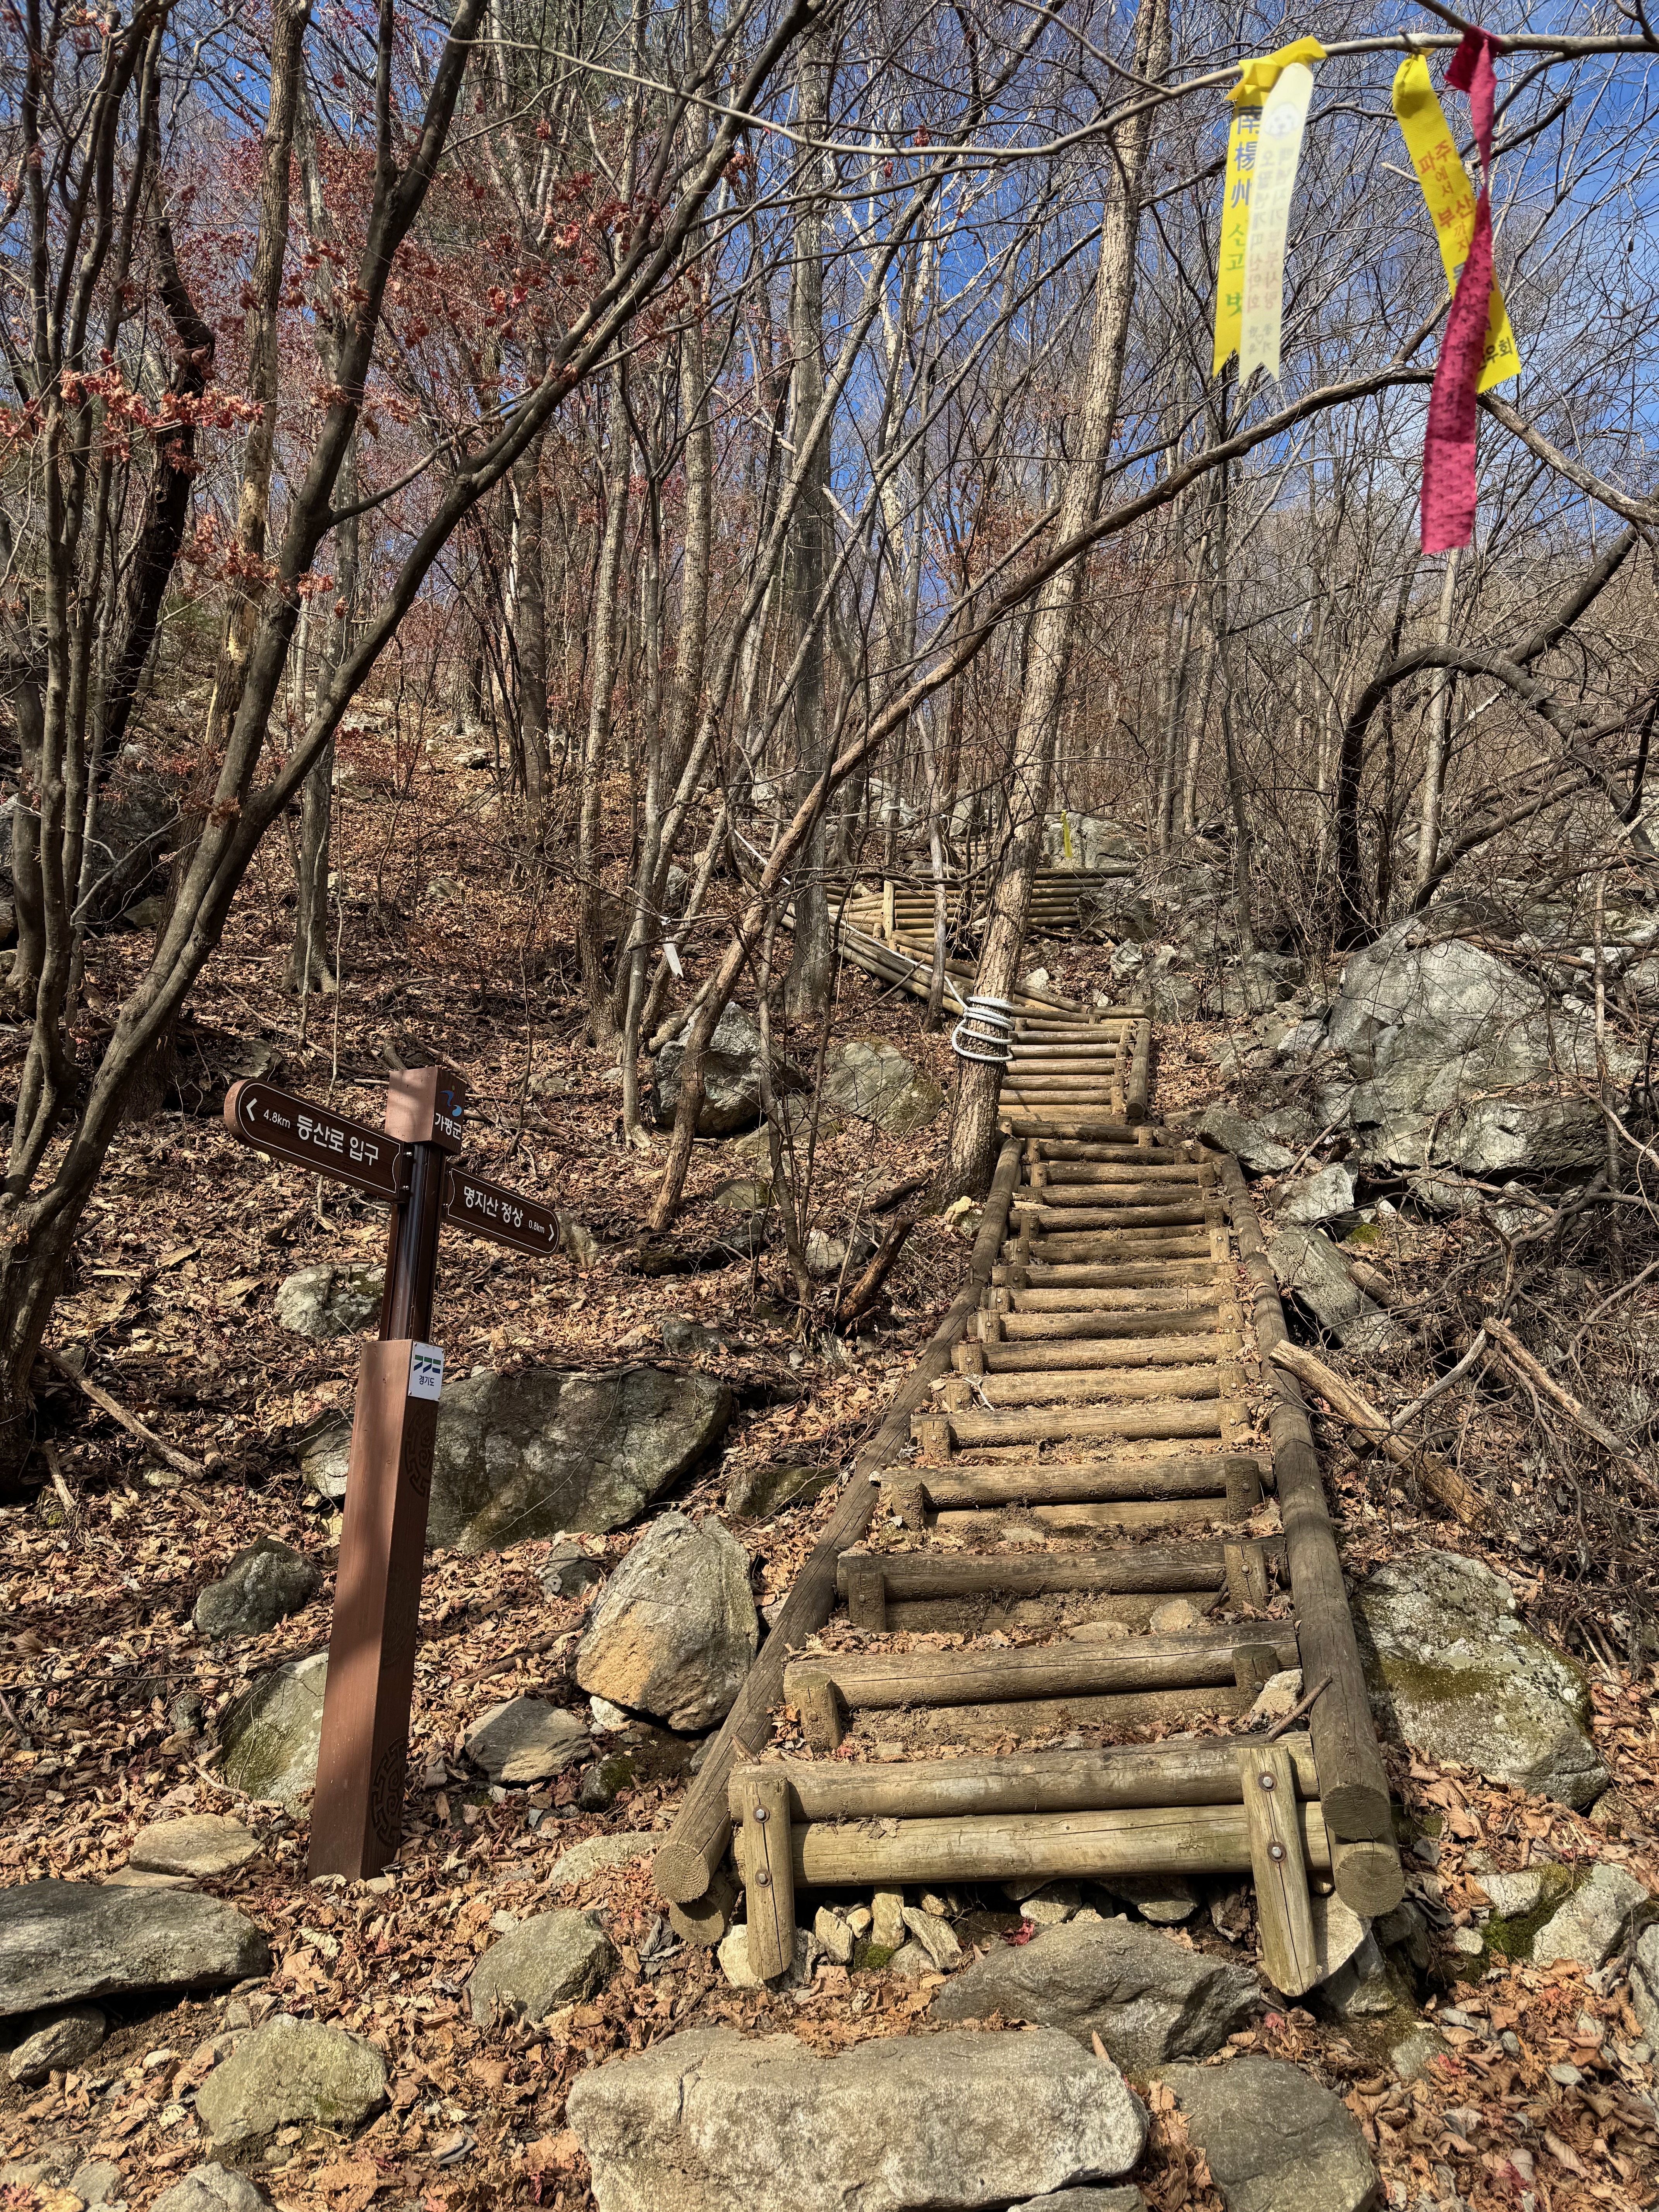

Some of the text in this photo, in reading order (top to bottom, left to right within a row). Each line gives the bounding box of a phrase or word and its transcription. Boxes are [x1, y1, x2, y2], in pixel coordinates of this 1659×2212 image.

[1418, 139, 1452, 174] 파주
[1438, 194, 1474, 228] 부산
[263, 1109, 378, 1166] 4.8km 등산로 입구
[435, 1113, 461, 1140] 가평군
[464, 1186, 544, 1233] 명지산 정상 0.8km
[419, 1375, 434, 1386] 경기도
